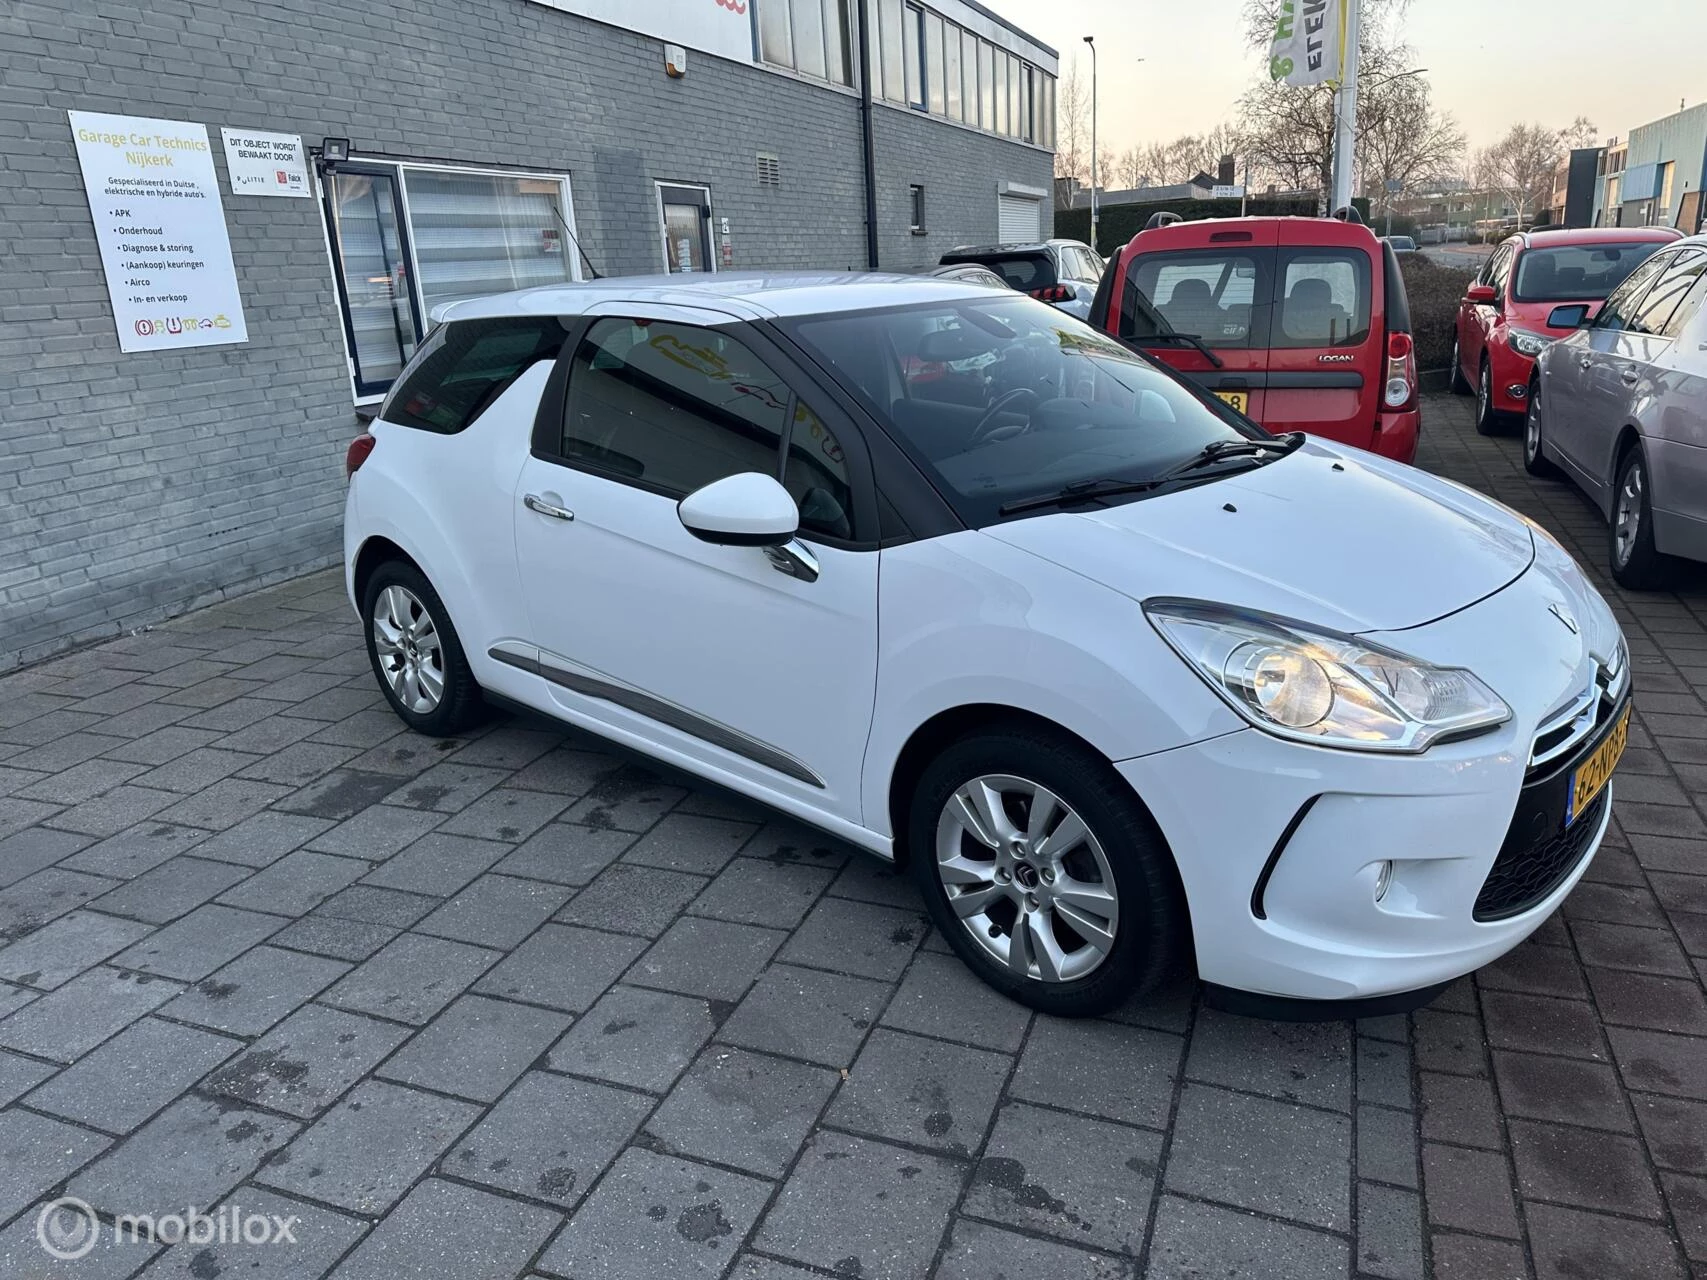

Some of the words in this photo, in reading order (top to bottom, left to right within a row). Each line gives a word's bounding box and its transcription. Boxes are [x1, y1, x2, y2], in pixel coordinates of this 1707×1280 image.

[78, 128, 127, 148] Garage
[129, 133, 152, 147] Car
[153, 135, 208, 151] Technics
[229, 138, 242, 147] DIT
[243, 139, 271, 149] OBJECT
[272, 142, 297, 151] WORDT
[125, 151, 174, 168] Nijkerk
[238, 150, 272, 160] BEWAAKT
[273, 153, 294, 162] DOOR
[108, 176, 164, 188] Gespecialiseerd
[165, 178, 173, 187] in
[104, 187, 145, 197] elektrische
[156, 188, 183, 199] hybride
[115, 208, 132, 218] APK
[118, 226, 163, 235] Onderhoud
[122, 244, 158, 254] Diagnose
[159, 244, 166, 252] &
[166, 244, 194, 254] storing
[126, 260, 166, 271] (Aankoop)
[166, 260, 205, 270] keuringen
[129, 278, 151, 287] Airco
[156, 293, 188, 303] verkoop
[1318, 354, 1355, 362] LOGAN
